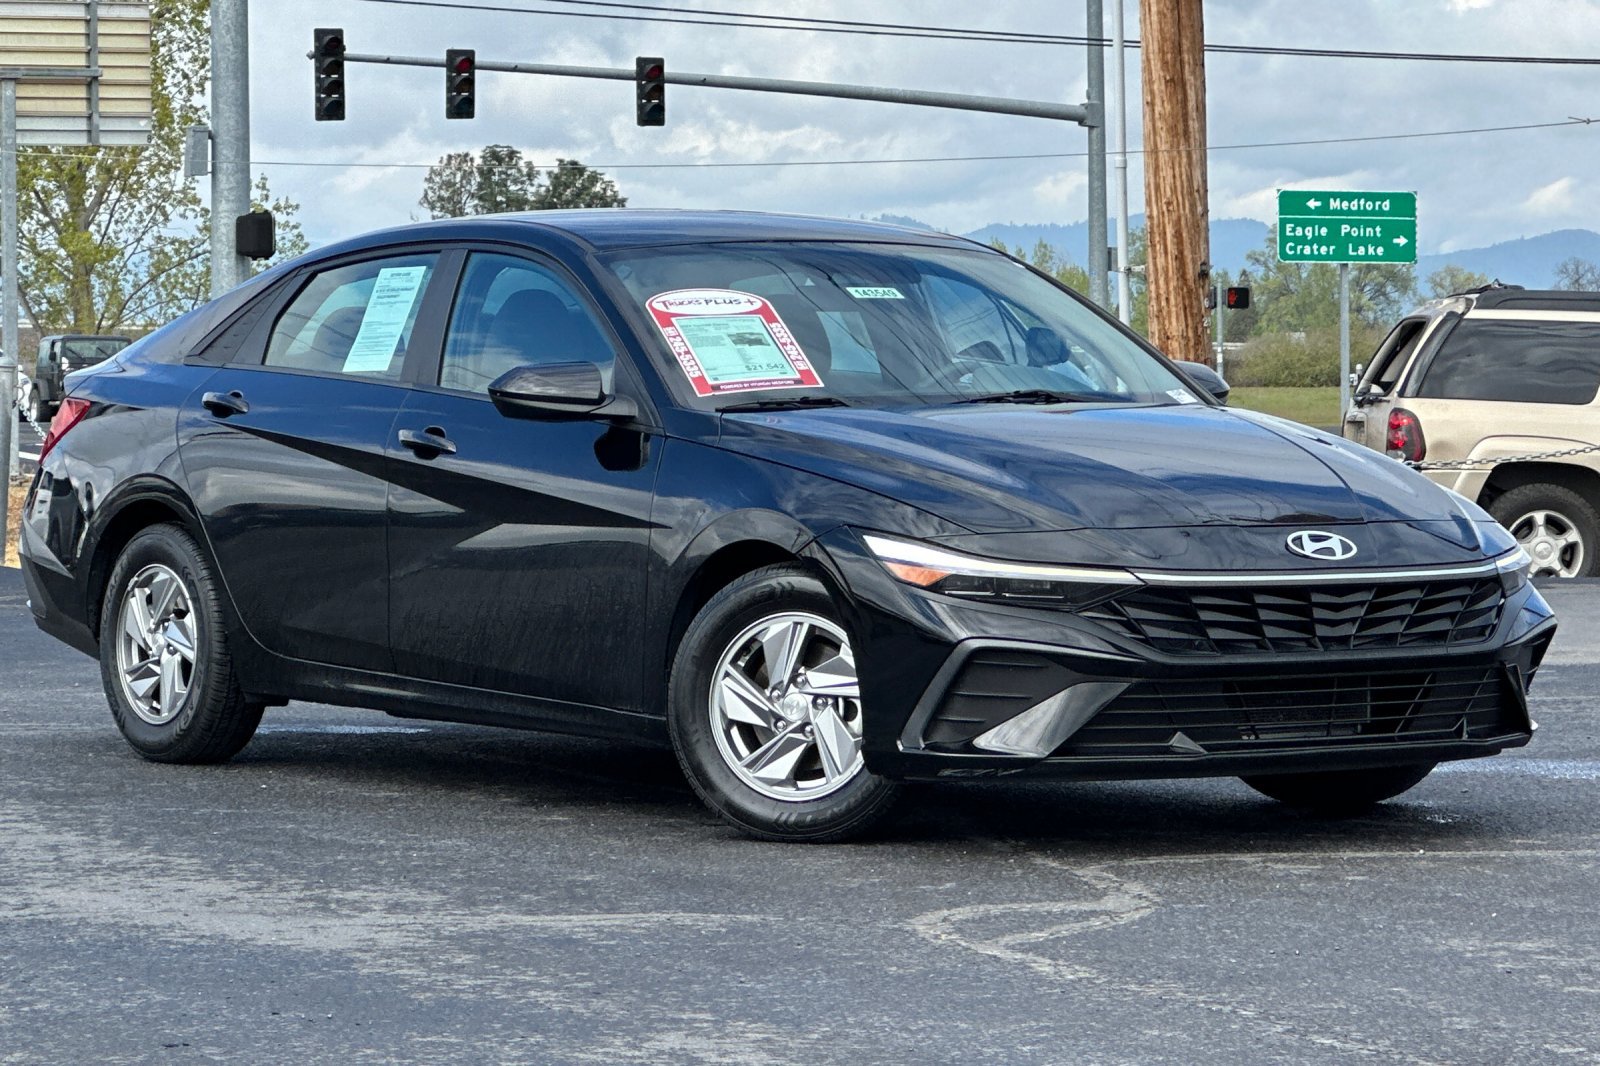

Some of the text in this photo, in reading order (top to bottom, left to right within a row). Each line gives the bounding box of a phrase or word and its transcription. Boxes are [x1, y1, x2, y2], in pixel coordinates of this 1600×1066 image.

[1330, 198, 1390, 211] Medford
[1286, 224, 1382, 240] Eagle Point
[1286, 243, 1385, 256] Crater Lake
